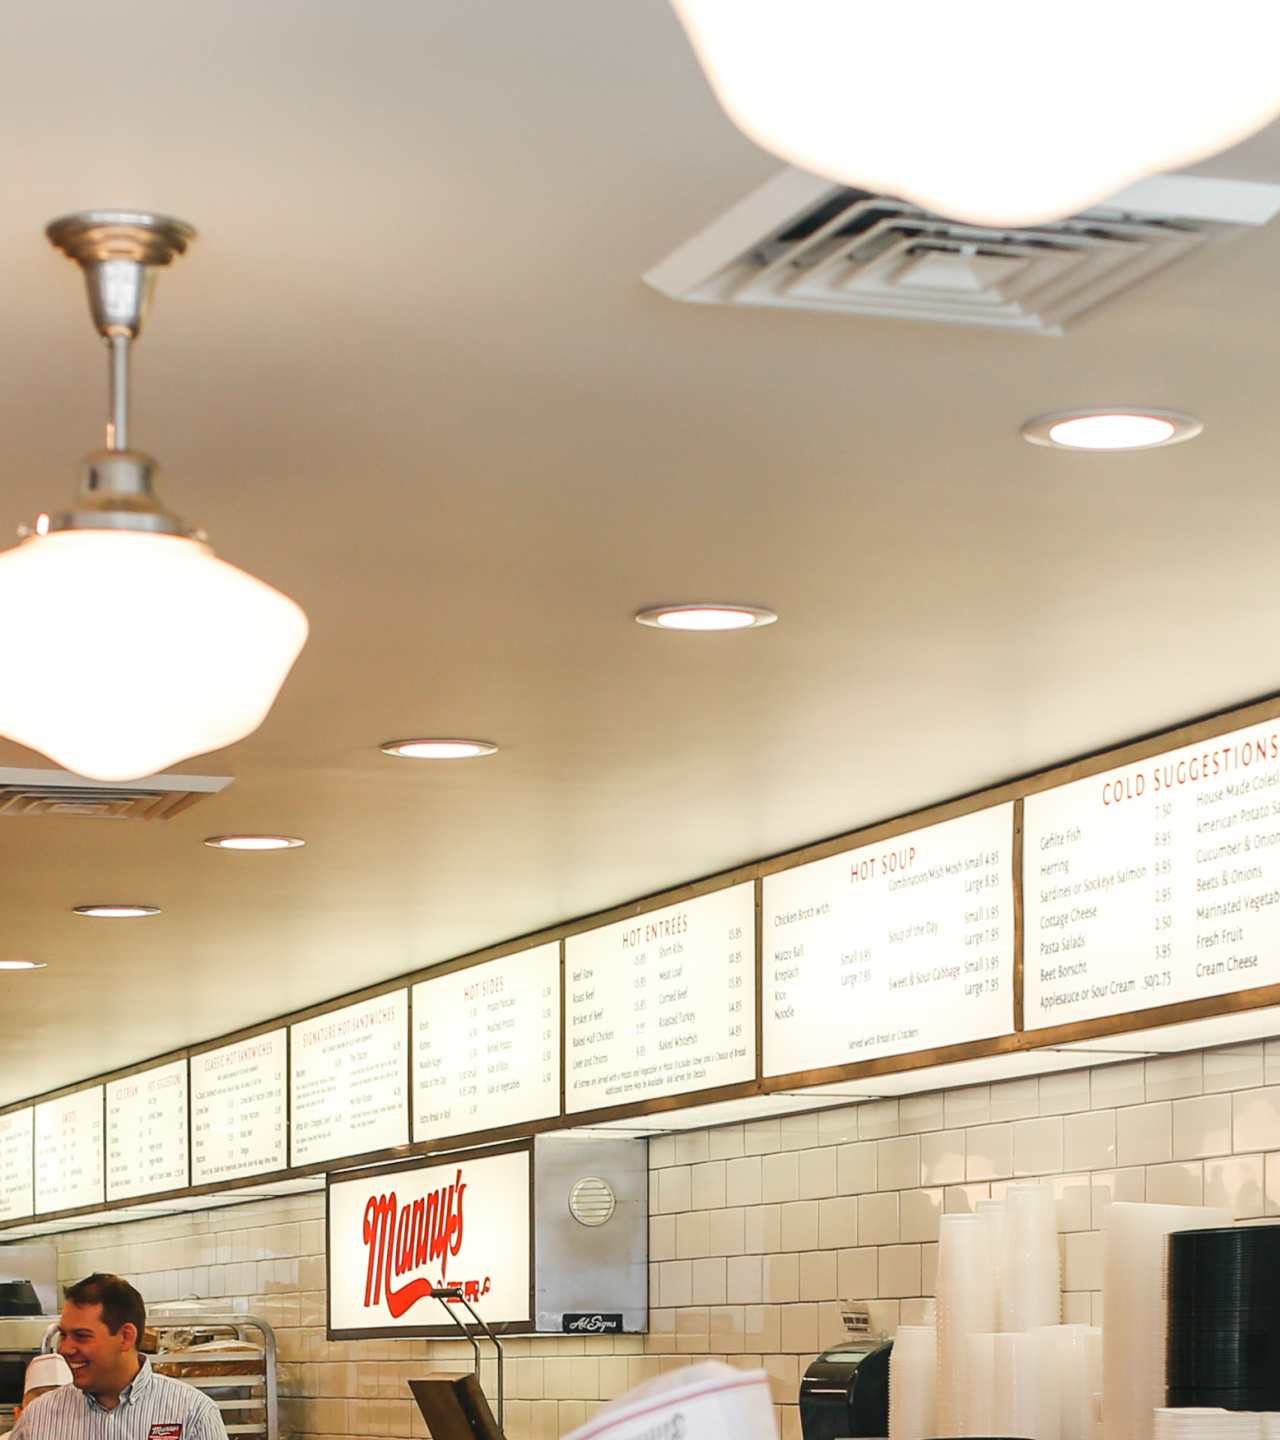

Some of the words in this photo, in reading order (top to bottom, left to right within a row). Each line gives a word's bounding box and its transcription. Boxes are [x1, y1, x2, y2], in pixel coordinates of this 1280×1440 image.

[1102, 773, 1144, 805] COLD
[1153, 734, 1278, 791] SUGGESTIONS
[1196, 789, 1223, 805] House
[1226, 780, 1250, 796] Made
[1196, 813, 1238, 833] American
[1239, 805, 1269, 822] Potato
[1039, 831, 1064, 850] Gefilte
[1065, 825, 1081, 843] Fish
[1196, 842, 1242, 863] Cucumber
[1244, 835, 1251, 851] &
[850, 857, 875, 882] HOT
[881, 846, 915, 875] SOUP
[1040, 859, 1069, 877] Herring
[1039, 886, 1071, 903] Sardines
[1072, 882, 1082, 895] or
[1083, 874, 1114, 892] Sockeye
[1116, 866, 1146, 884] Salmon
[1196, 876, 1219, 892] Beets
[1221, 870, 1228, 886] &
[1230, 866, 1263, 884] Onions
[774, 911, 797, 927] Chicken
[797, 906, 814, 920] Broth
[1039, 913, 1068, 930] Cottage
[1070, 906, 1097, 922] Cheese
[1196, 899, 1241, 919] Marinated
[622, 927, 641, 947] HOT
[888, 930, 904, 944] Soup
[913, 924, 924, 936] the
[925, 921, 938, 934] Day
[1196, 931, 1219, 948] Fresh
[1221, 927, 1243, 943] Fruit
[1040, 941, 1060, 955] Pasta
[1061, 935, 1085, 951] Salads
[1040, 967, 1056, 982] Beet
[1057, 959, 1087, 978] Borscht
[1196, 961, 1224, 978] Cream
[1226, 955, 1258, 971] Cheese
[1040, 991, 1080, 1011] Applesauce
[1080, 988, 1089, 1000] or
[1090, 984, 1108, 999] Sour
[1109, 980, 1135, 995] Cream
[363, 1168, 467, 1319] Manny's
